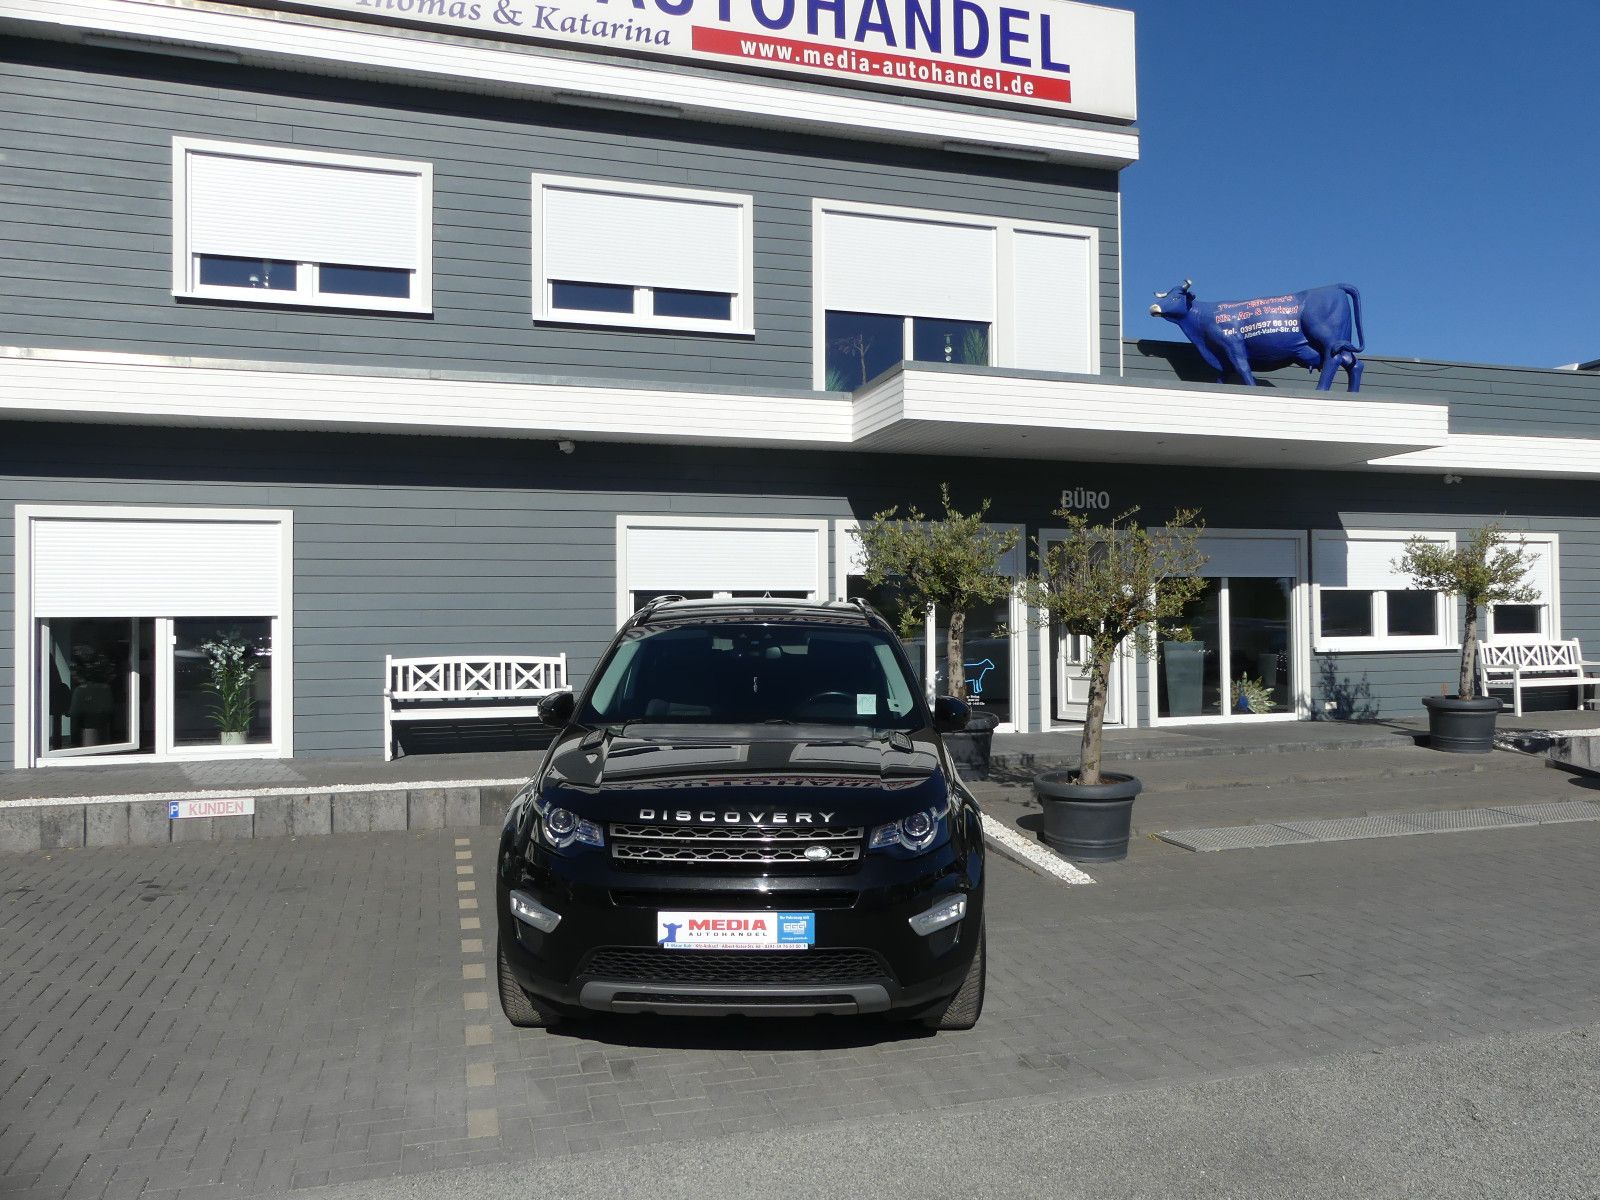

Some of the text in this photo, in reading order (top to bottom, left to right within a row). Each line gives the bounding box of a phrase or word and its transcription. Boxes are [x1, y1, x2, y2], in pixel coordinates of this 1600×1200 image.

[493, 0, 523, 26] &
[532, 5, 671, 46] Katarina
[740, 38, 1035, 96] www.media-autohandel.de
[1223, 328, 1237, 336] Tel.
[1240, 320, 1272, 333] 0391/597
[1284, 319, 1298, 327] 100
[1062, 487, 1110, 509] BÜRO
[170, 801, 244, 816] P KUNDEN
[639, 808, 836, 823] DISCOVERY
[688, 919, 767, 931] MEDIA
